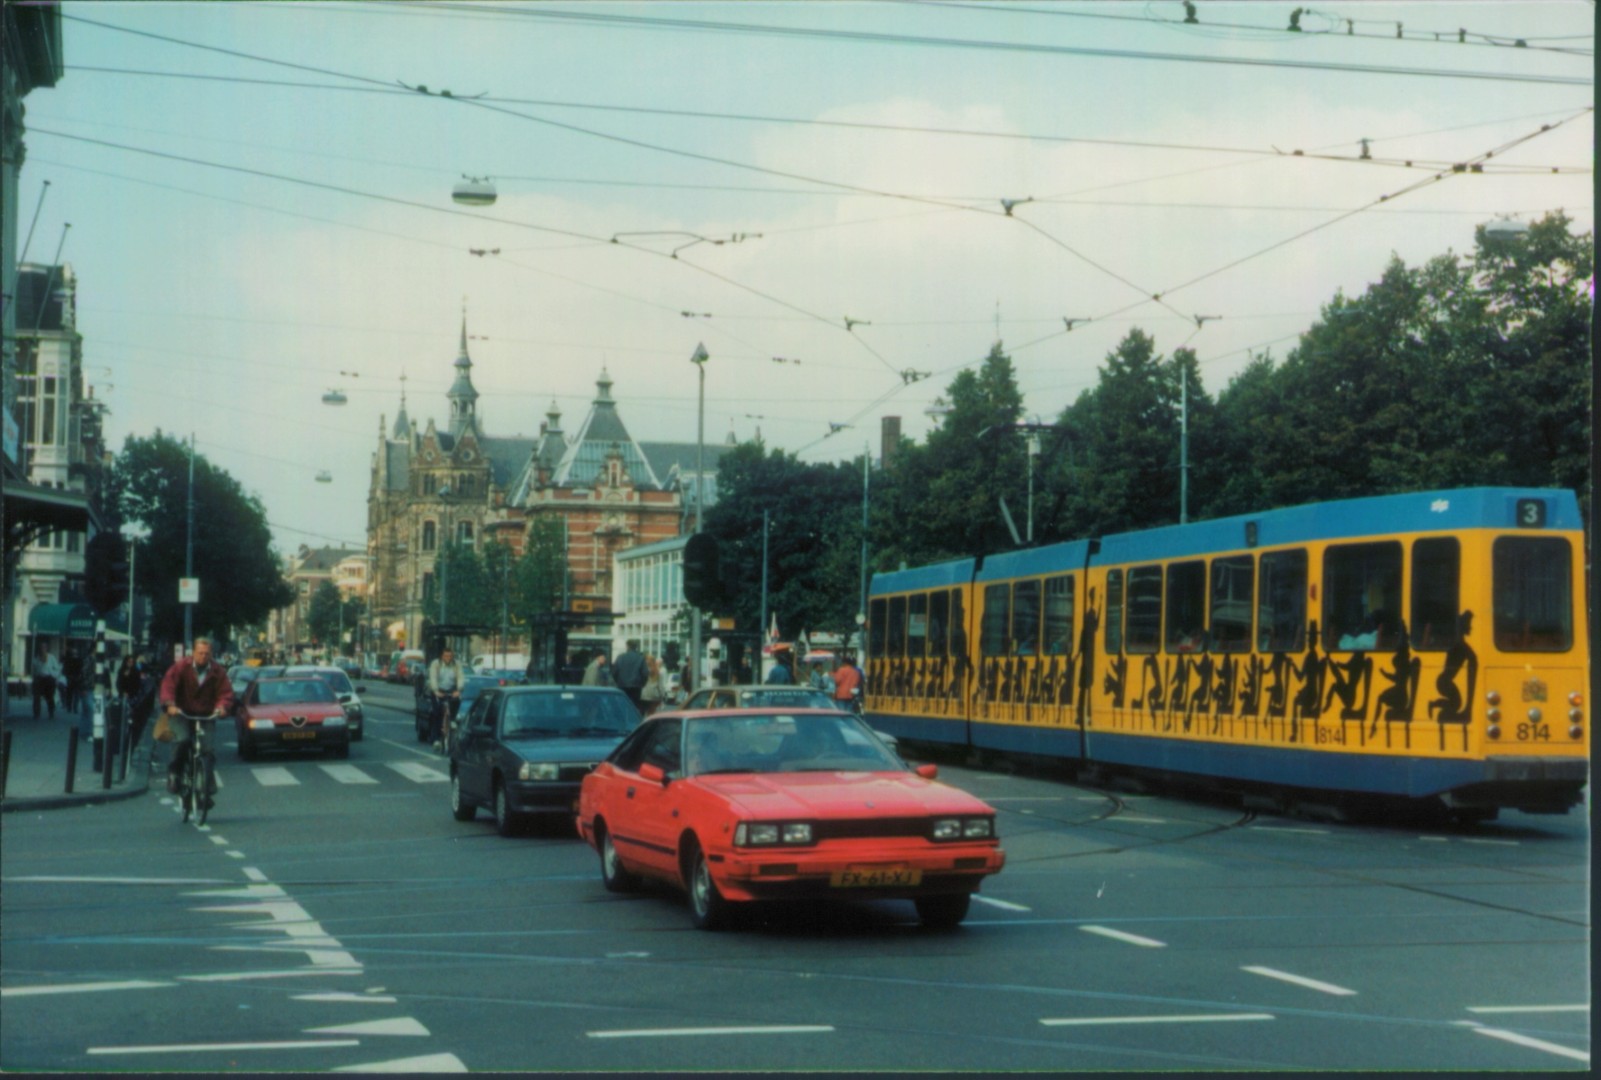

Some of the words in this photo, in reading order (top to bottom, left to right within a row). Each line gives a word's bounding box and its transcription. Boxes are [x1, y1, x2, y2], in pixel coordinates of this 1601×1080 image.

[1524, 503, 1538, 524] 3
[1319, 726, 1342, 744] 814
[1516, 722, 1551, 741] 814
